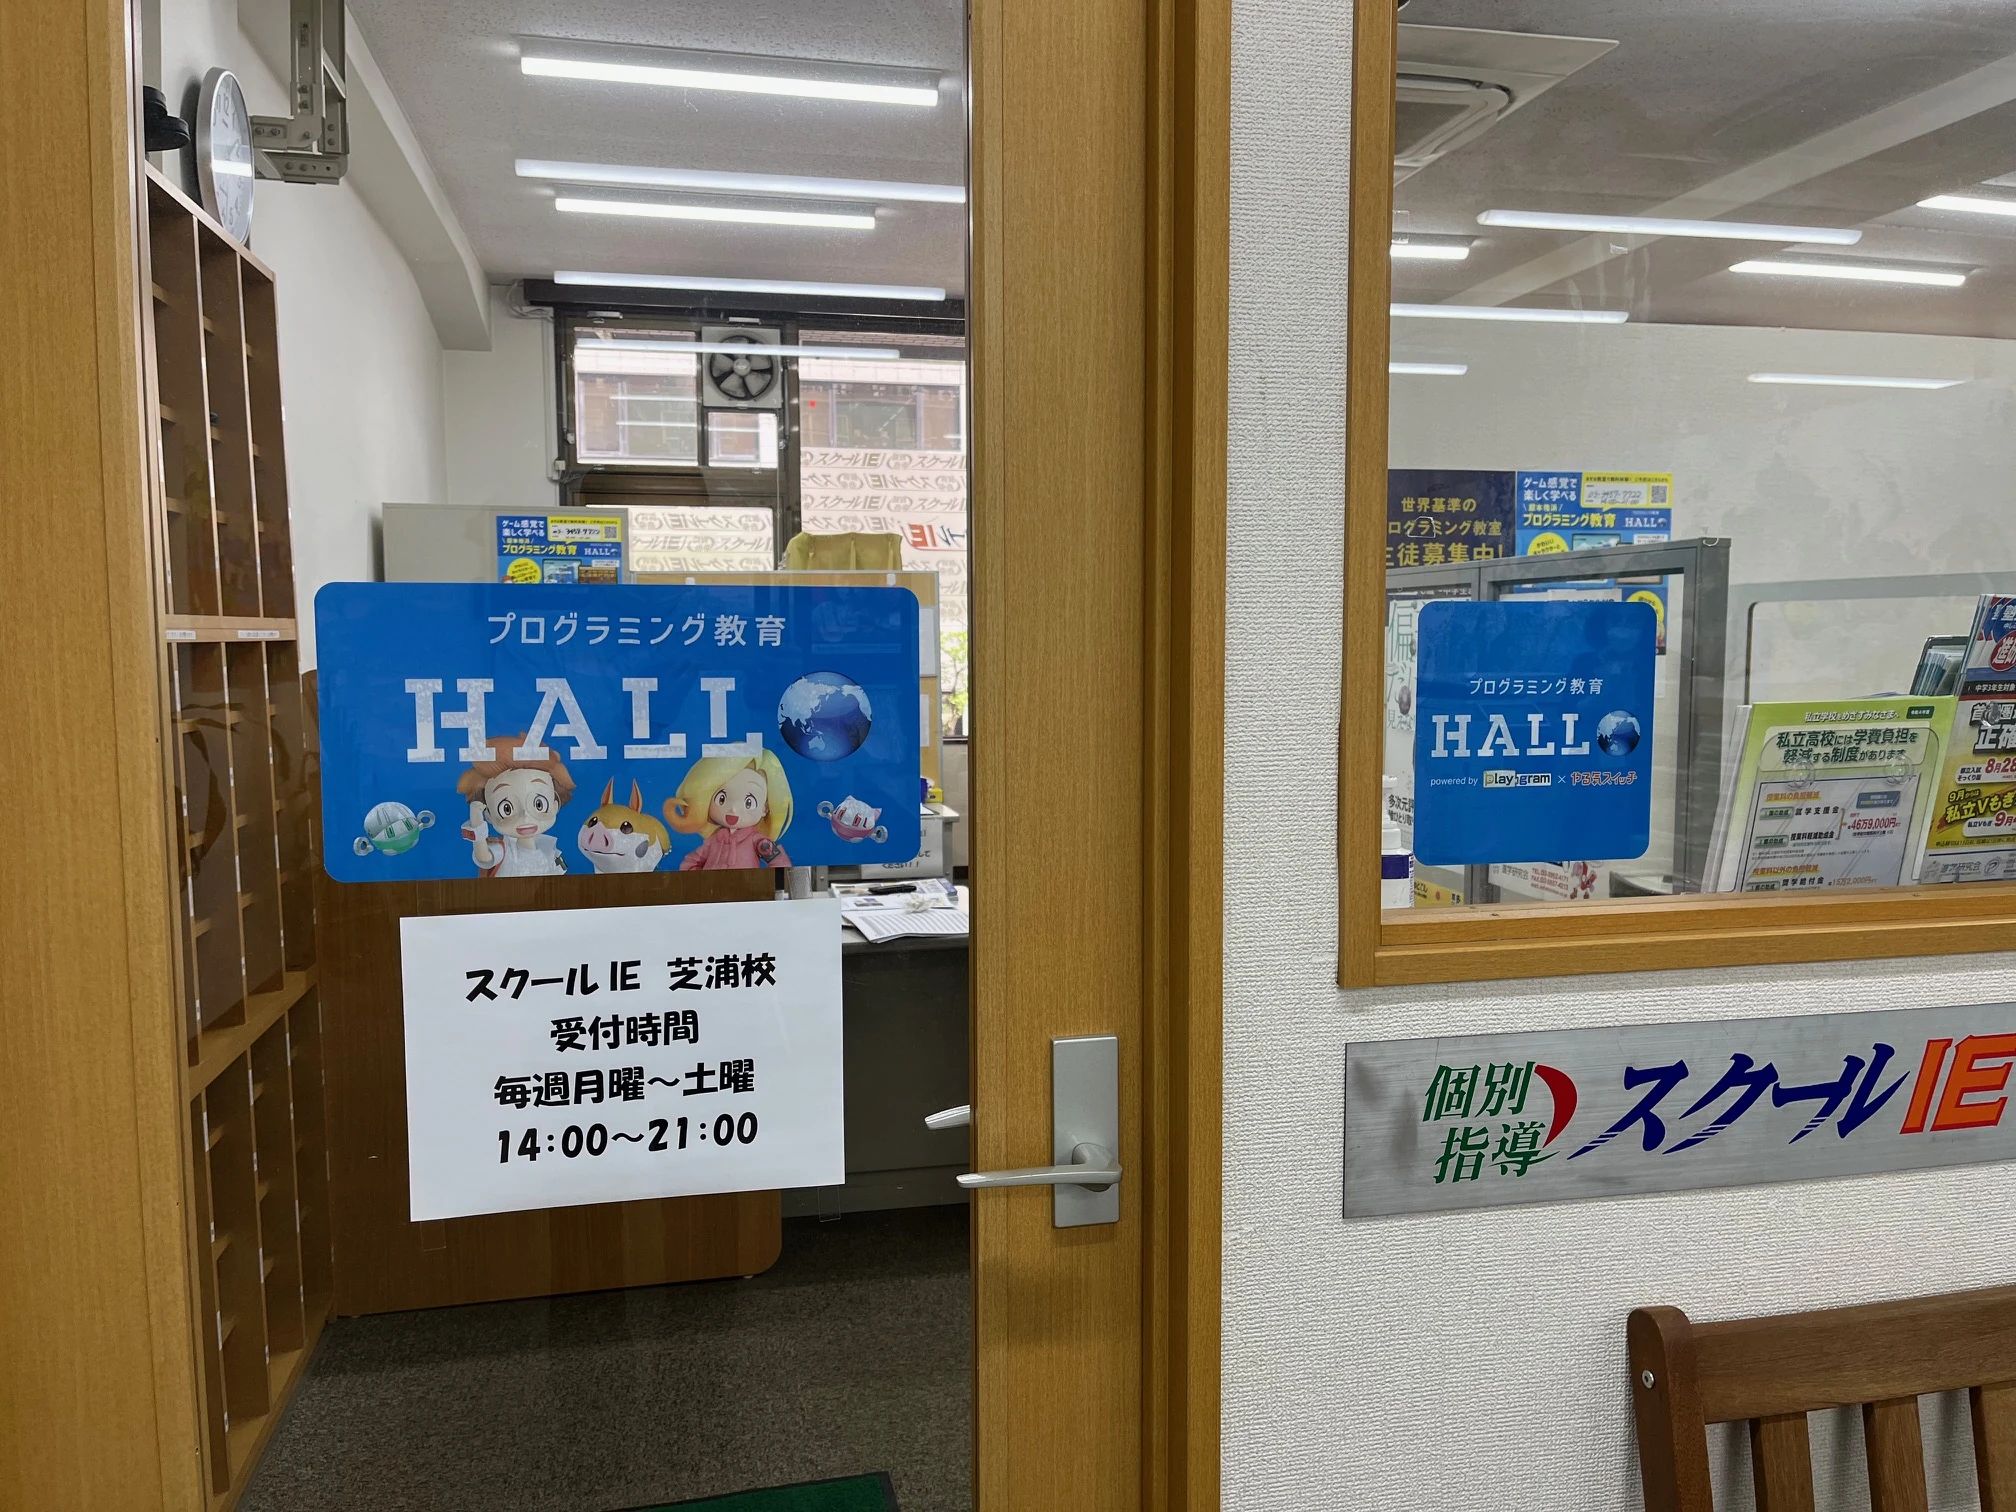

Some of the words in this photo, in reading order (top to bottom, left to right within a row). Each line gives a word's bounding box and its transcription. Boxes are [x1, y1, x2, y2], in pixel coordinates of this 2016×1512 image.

[1523, 477, 1578, 489] ゲーム感覚で
[1401, 496, 1477, 513] 世界基準の
[1523, 489, 1577, 501] 楽しく学べる
[1523, 513, 1616, 528] プログラミング教育
[502, 544, 577, 555] プログラミング教育
[488, 612, 787, 647] プログラミング教育
[1469, 677, 1604, 696] プログラミング教育
[1777, 727, 1918, 749] 私立高校には学費負担を
[1783, 747, 1907, 764] 軽減する制度があります
[1431, 776, 1466, 787] powered
[1468, 775, 1478, 786] by
[1571, 771, 1638, 787] やる気スイッチ
[465, 960, 642, 1002] スクールIE
[667, 952, 777, 992] 芝浦校
[550, 1009, 699, 1053] 受付時間
[493, 1058, 755, 1110] 毎週月曜～土曜
[1422, 1060, 1537, 1122] 個別
[1433, 1121, 1560, 1184] 指導
